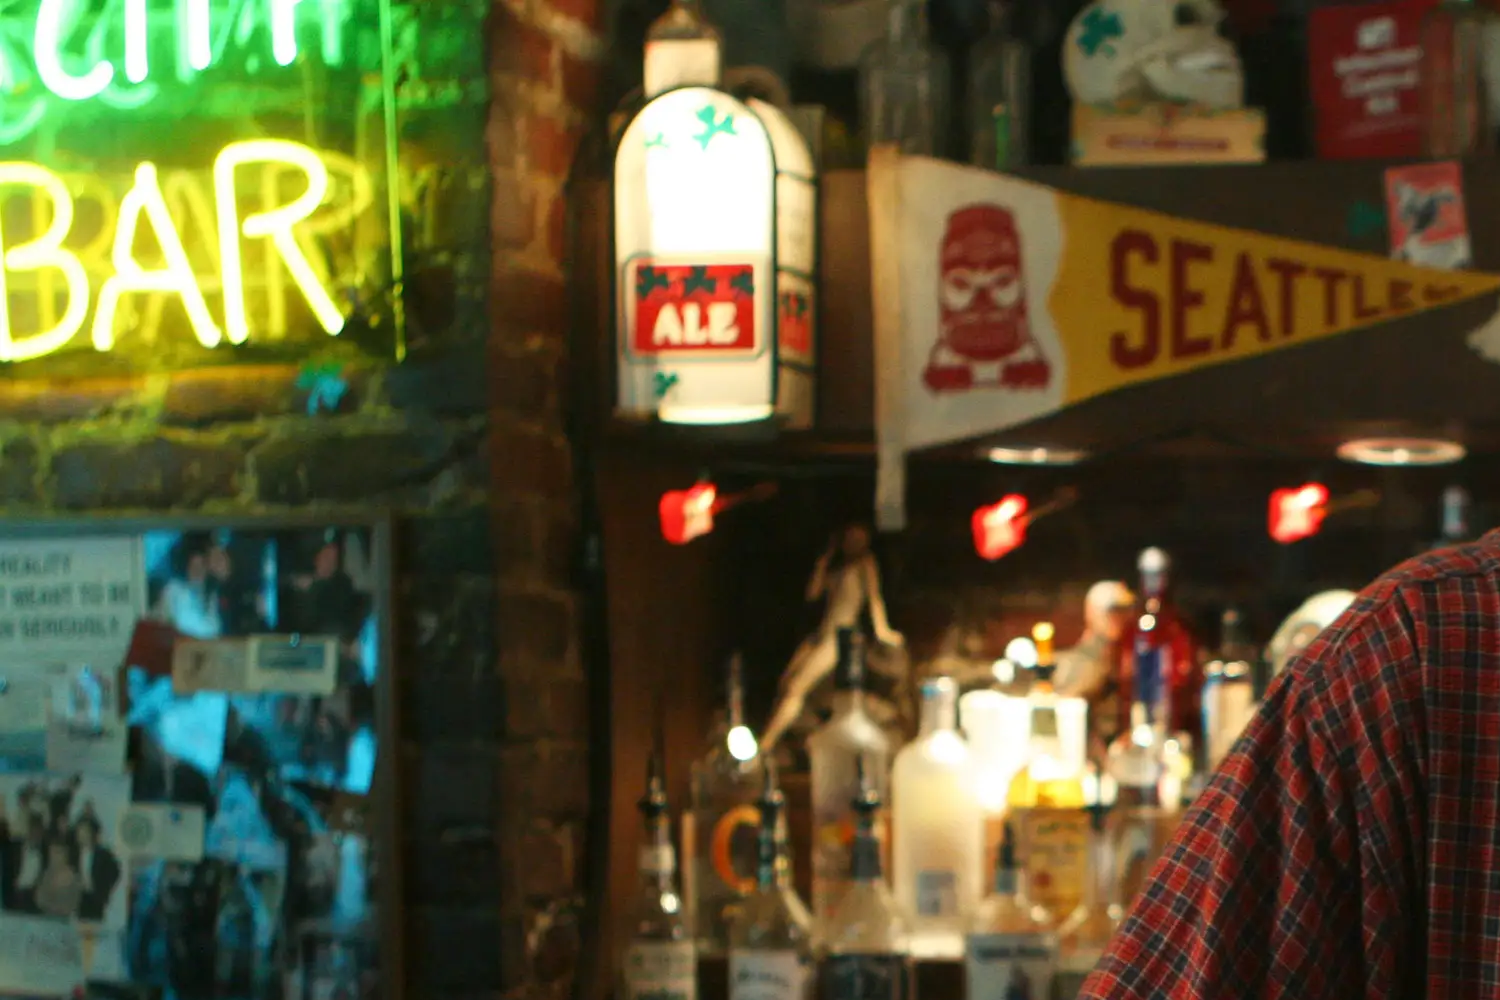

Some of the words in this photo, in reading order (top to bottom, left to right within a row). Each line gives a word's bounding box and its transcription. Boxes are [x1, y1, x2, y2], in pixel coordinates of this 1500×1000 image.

[0, 137, 346, 362] BAR
[1109, 229, 1414, 371] SEATTLE
[652, 301, 740, 346] ALE
